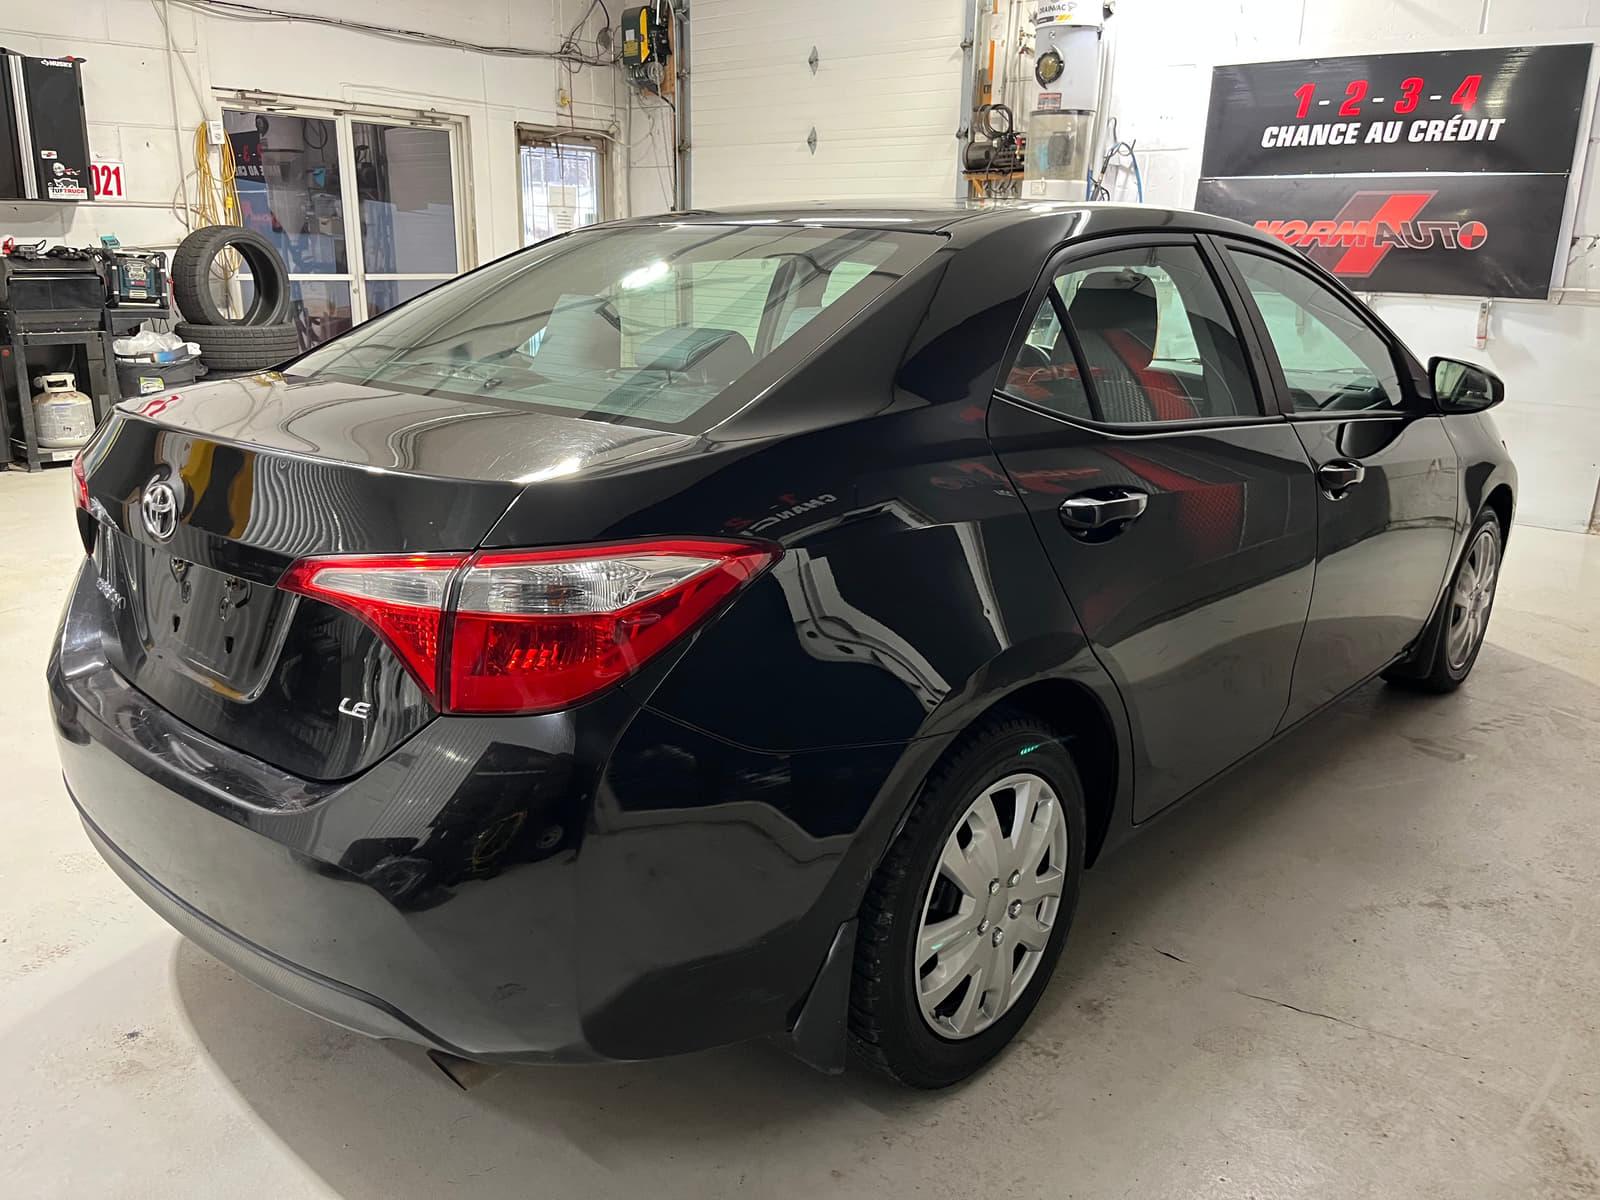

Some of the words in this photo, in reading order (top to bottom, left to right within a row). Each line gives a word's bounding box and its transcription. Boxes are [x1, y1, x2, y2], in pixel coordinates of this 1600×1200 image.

[1261, 122, 1361, 149] CHANCE
[1365, 121, 1403, 144] AU
[1407, 114, 1506, 142] CRÉDIT
[338, 697, 371, 719] LE
